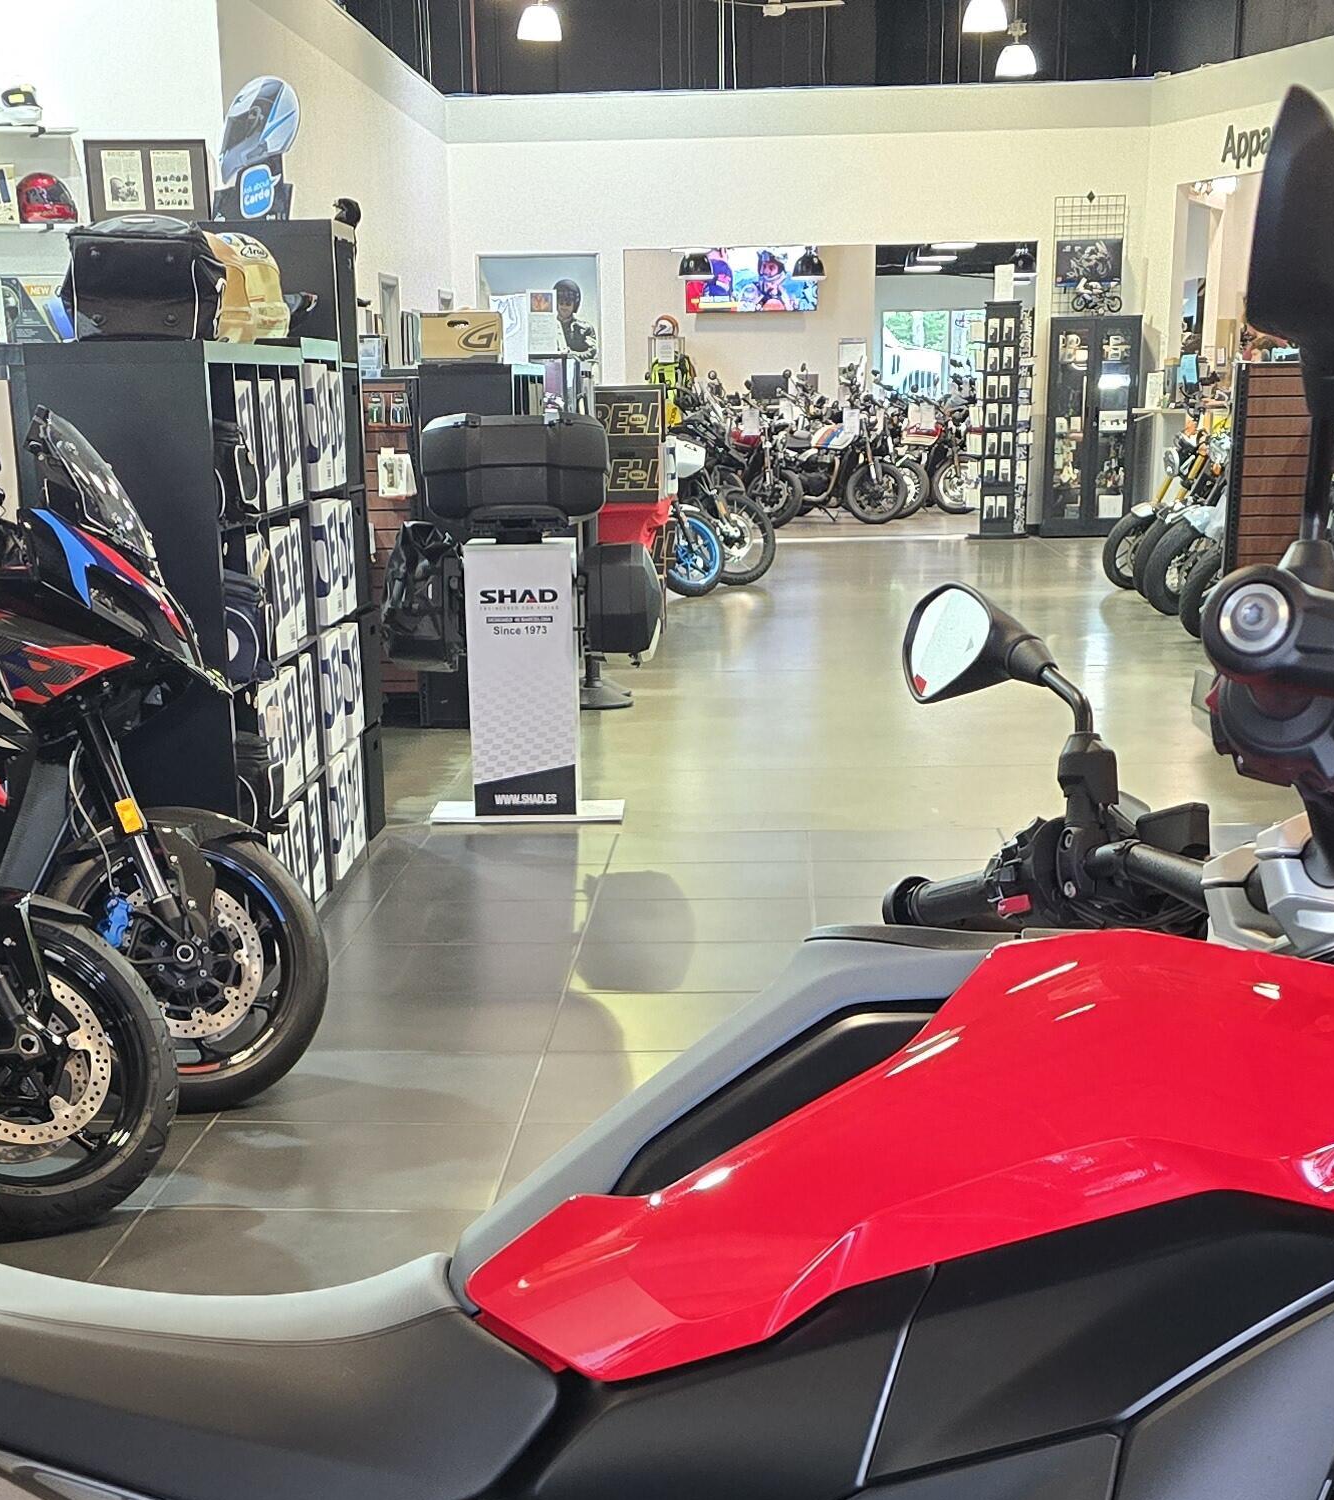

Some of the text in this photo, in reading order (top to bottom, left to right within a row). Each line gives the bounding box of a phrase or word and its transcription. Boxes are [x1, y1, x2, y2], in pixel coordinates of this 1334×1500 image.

[1221, 125, 1271, 169] Appa
[244, 191, 270, 206] Cardo
[31, 286, 51, 295] NEW
[479, 589, 558, 604] SHAD
[493, 626, 548, 636] Since 1973
[494, 794, 558, 805] WWW.SHAD.ES
